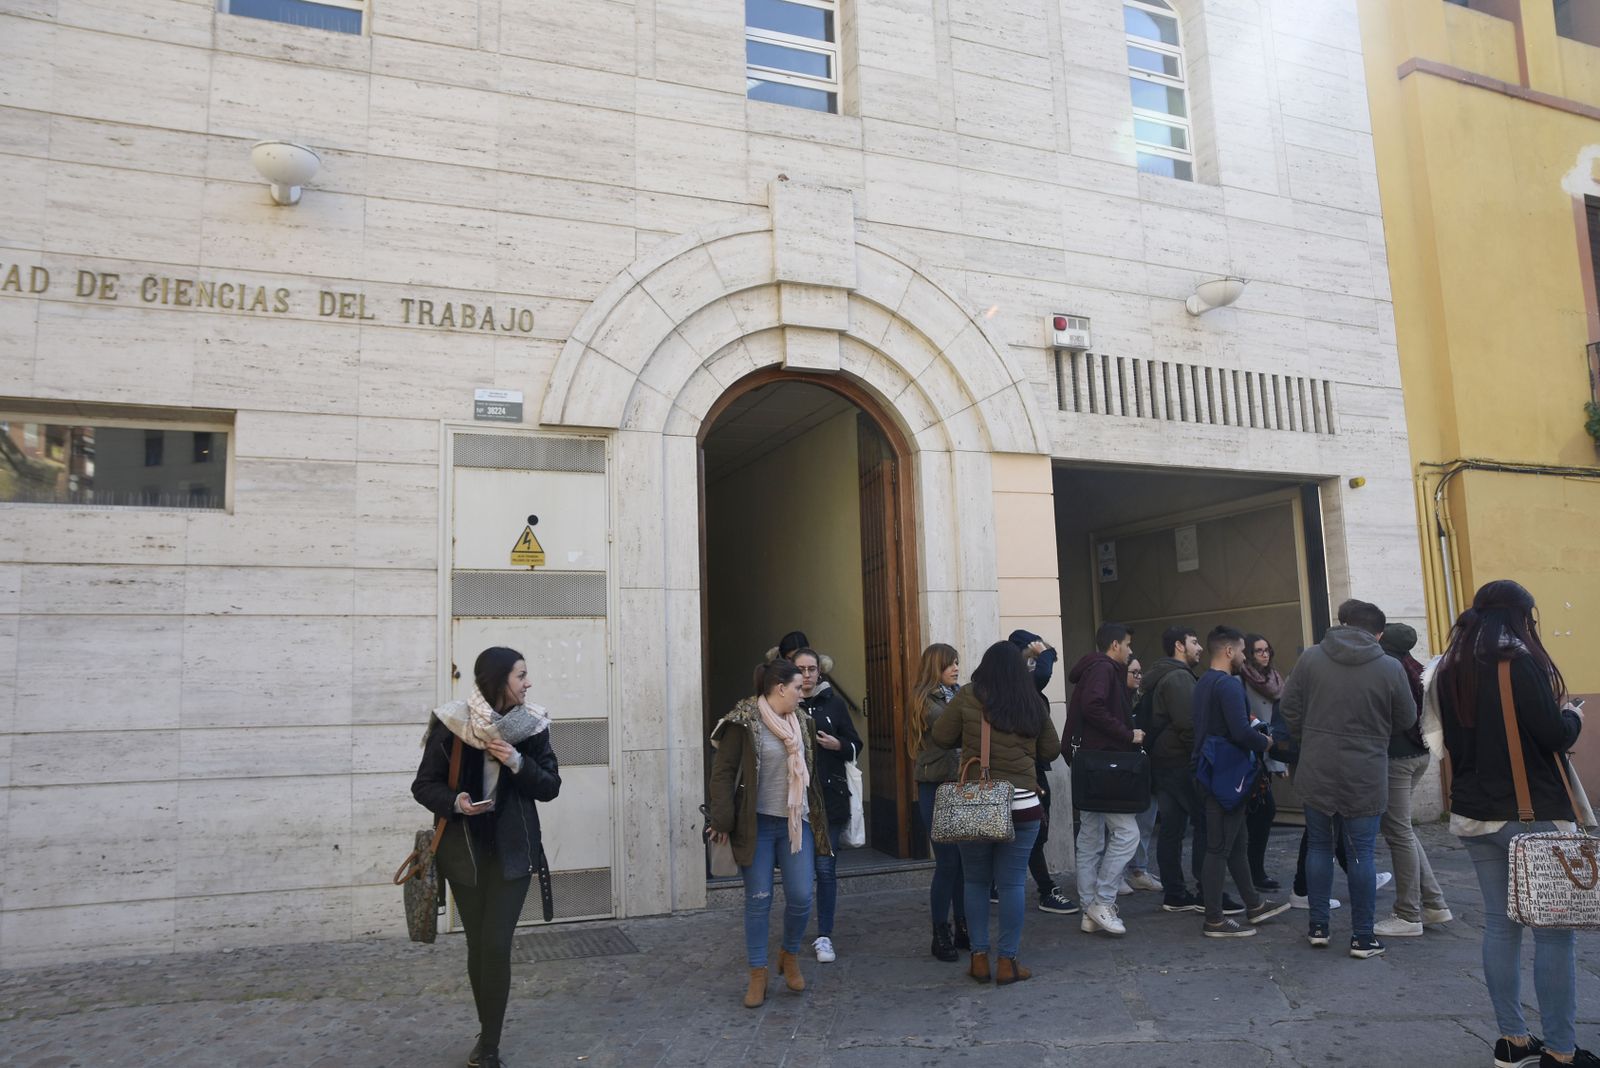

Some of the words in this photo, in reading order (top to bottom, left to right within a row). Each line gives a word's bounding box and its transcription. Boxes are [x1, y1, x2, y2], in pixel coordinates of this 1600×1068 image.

[0, 262, 50, 293] AD
[76, 269, 120, 300] DE
[140, 275, 290, 313] CIENCIAS
[319, 290, 375, 320] DEL
[401, 298, 534, 333] TRABAJO
[1537, 890, 1567, 900] ADVENTURE
